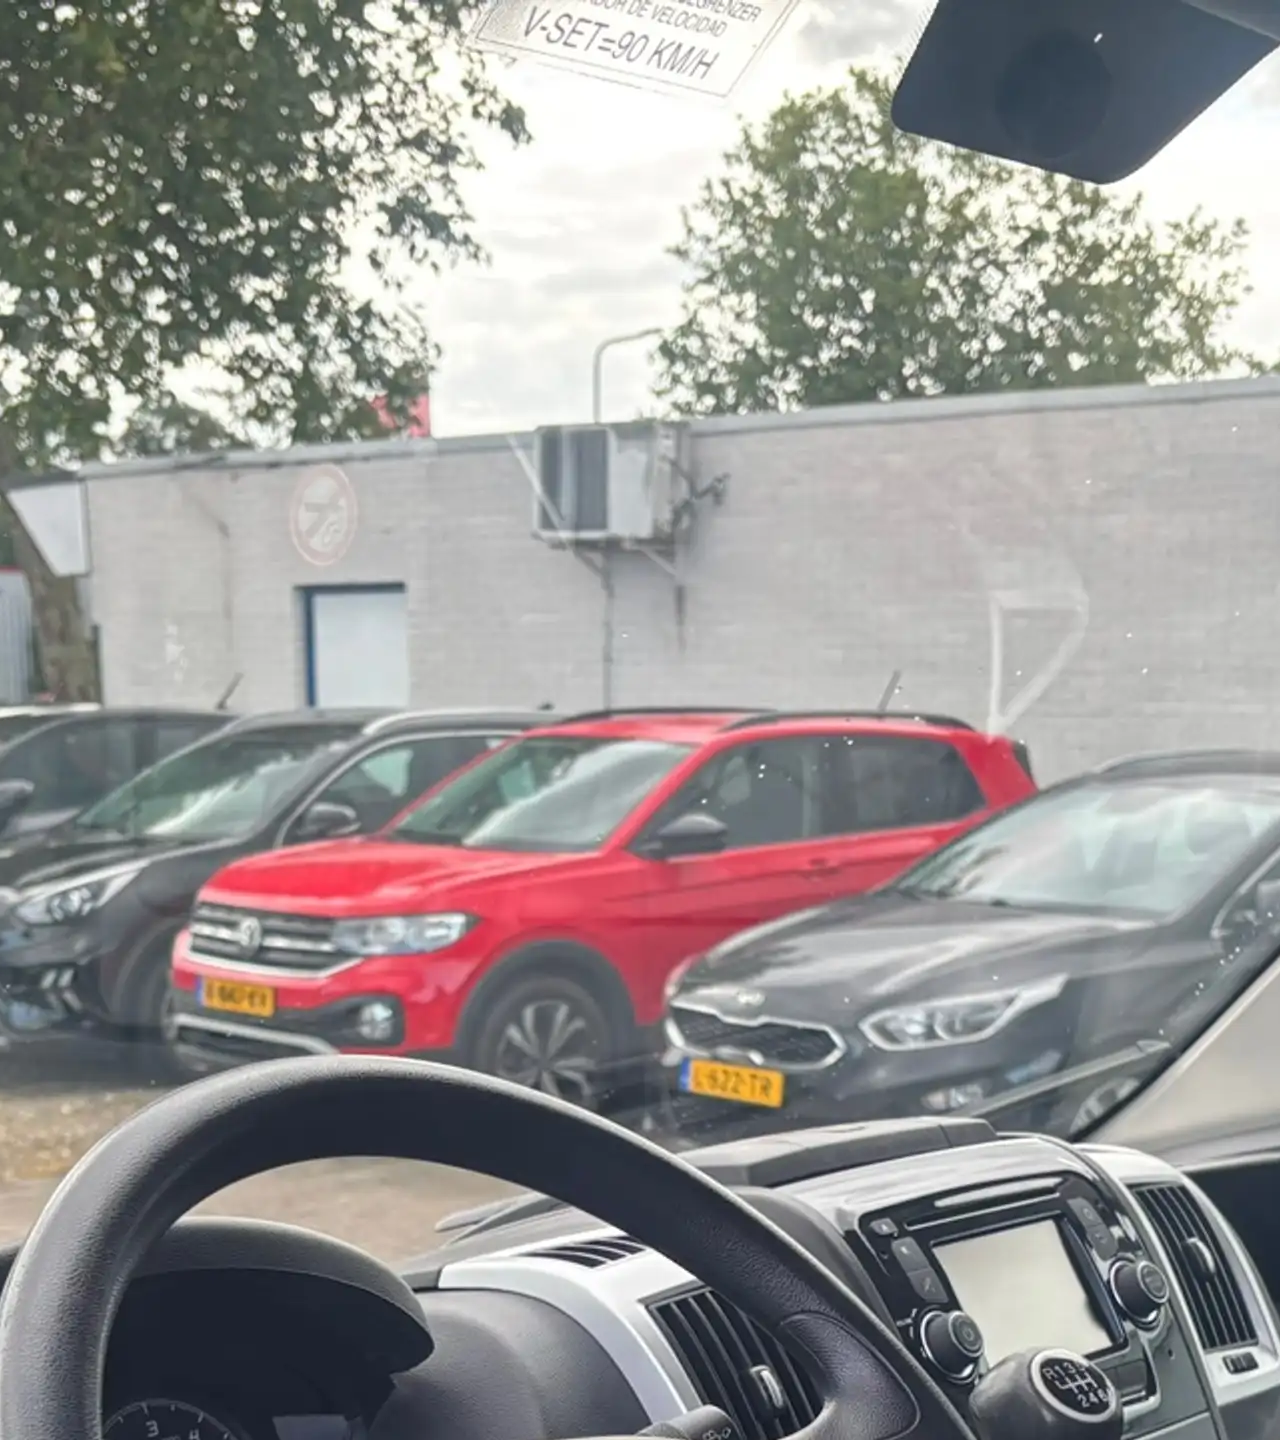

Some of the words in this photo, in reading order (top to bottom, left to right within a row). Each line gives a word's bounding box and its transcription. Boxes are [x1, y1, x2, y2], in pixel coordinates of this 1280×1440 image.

[651, 4, 728, 38] VELOCIDAD
[523, 6, 650, 62] V-SET=90
[646, 37, 720, 80] KM/H
[145, 1420, 159, 1438] 3
